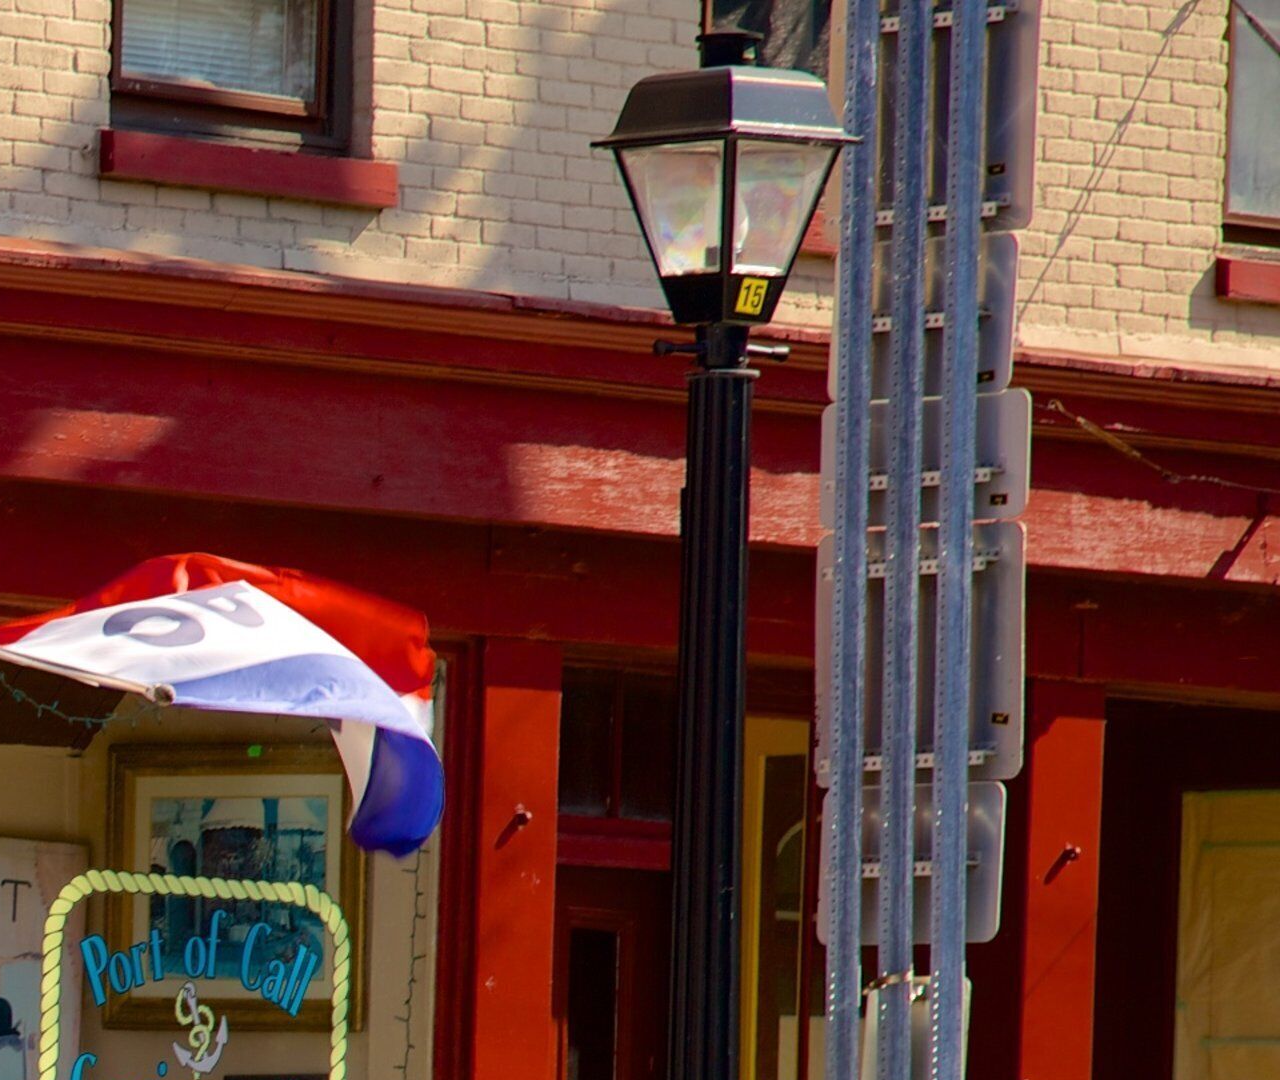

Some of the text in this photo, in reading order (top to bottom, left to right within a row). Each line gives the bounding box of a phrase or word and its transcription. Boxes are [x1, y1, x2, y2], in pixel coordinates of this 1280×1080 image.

[743, 284, 767, 310] 15
[79, 909, 319, 1018] Port of Call
